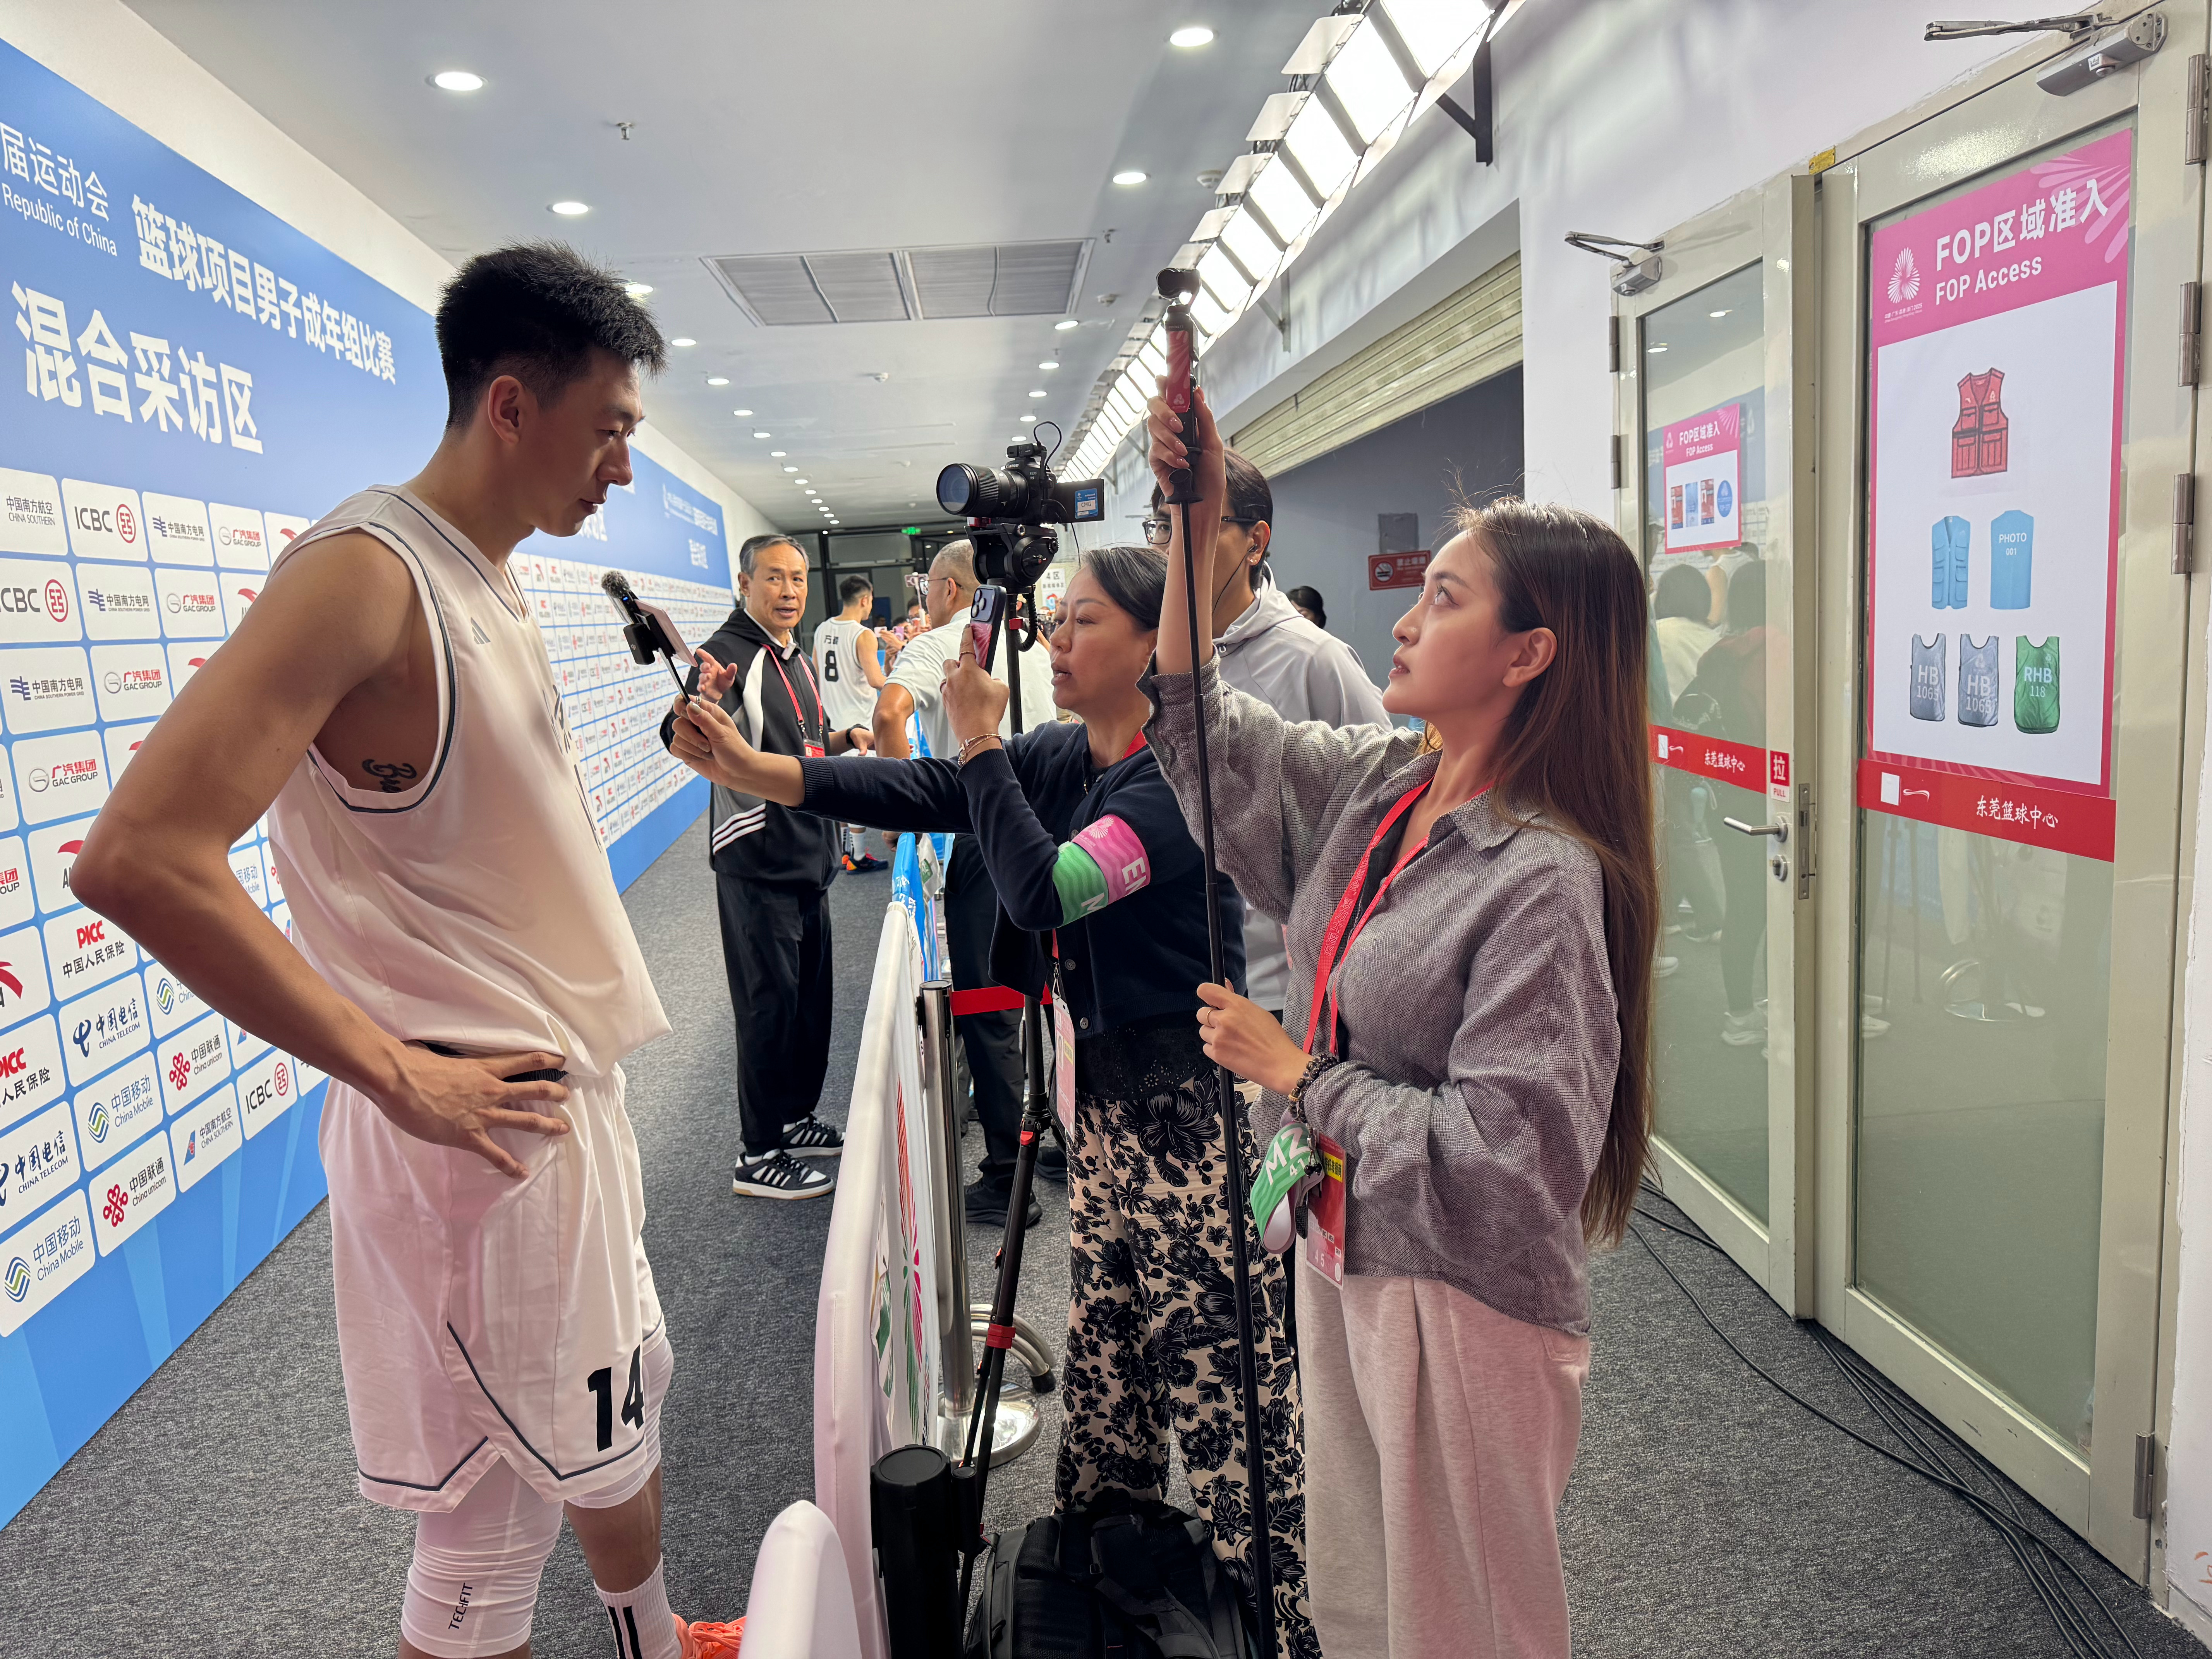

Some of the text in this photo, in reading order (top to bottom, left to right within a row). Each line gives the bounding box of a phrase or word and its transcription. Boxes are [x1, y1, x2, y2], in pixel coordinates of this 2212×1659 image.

[0, 122, 110, 222] 届运动会
[2, 183, 117, 257] Republic of China
[1937, 179, 2108, 271] FOP区域准入
[132, 194, 396, 385] 篮球项目男子成年组比赛
[1936, 256, 2042, 305] FOP Access
[12, 281, 263, 454] 混合采访区
[1680, 421, 1720, 446] FOP区域准入
[1686, 443, 1713, 457] FOP Access
[6, 495, 53, 515] 中国南方航空
[9, 512, 55, 526] CHINA SOUTHERN
[74, 506, 113, 532] ICBC
[168, 522, 204, 537] 中国南方电网
[232, 529, 260, 541] 广汽集团
[1999, 532, 2027, 543] PHOTO
[0, 587, 40, 613] CBC
[106, 594, 149, 607] 中国南方电网
[183, 594, 215, 605] 广汽集团
[124, 669, 161, 683] 广汽集团
[825, 650, 839, 682] 8
[1918, 665, 1939, 685] HB
[2024, 666, 2052, 683] RHB
[32, 677, 83, 694] 中国南方电网
[124, 681, 162, 691] GAC GROUP
[1967, 675, 1991, 696] HB
[2030, 686, 2045, 697] 118
[52, 759, 97, 779] 广汽集团
[1704, 749, 1745, 773] 东莞篮球中心
[1774, 754, 1786, 781] 拉
[52, 771, 98, 787] GAC GROUP
[1774, 788, 1786, 798] PULL
[1976, 795, 2058, 830] 东莞篮球中心
[76, 920, 105, 949] PICC
[63, 940, 125, 978] 中国人民保险
[96, 998, 138, 1039] 中国电信
[100, 1022, 140, 1049] CHINA TELECOM
[191, 1034, 221, 1063] 中国联通
[207, 1052, 222, 1067] unicom
[111, 1075, 151, 1112] 中国移动
[246, 1079, 272, 1114] ICBC
[115, 1096, 153, 1127] China Mobile
[199, 1107, 232, 1139] 中国南方航空
[201, 1120, 233, 1148] CHINA SOUTHERN
[15, 1130, 66, 1182] 中国电信
[1266, 1127, 1310, 1185] MZ
[19, 1156, 68, 1194] CHINA TELECOM
[129, 1157, 165, 1193] 中国联通
[148, 1176, 166, 1195] unicom
[33, 1216, 81, 1264] 中国移动
[37, 1239, 84, 1281] China Mobile
[587, 1345, 644, 1452] 14
[448, 1582, 473, 1630] TECHFIT
